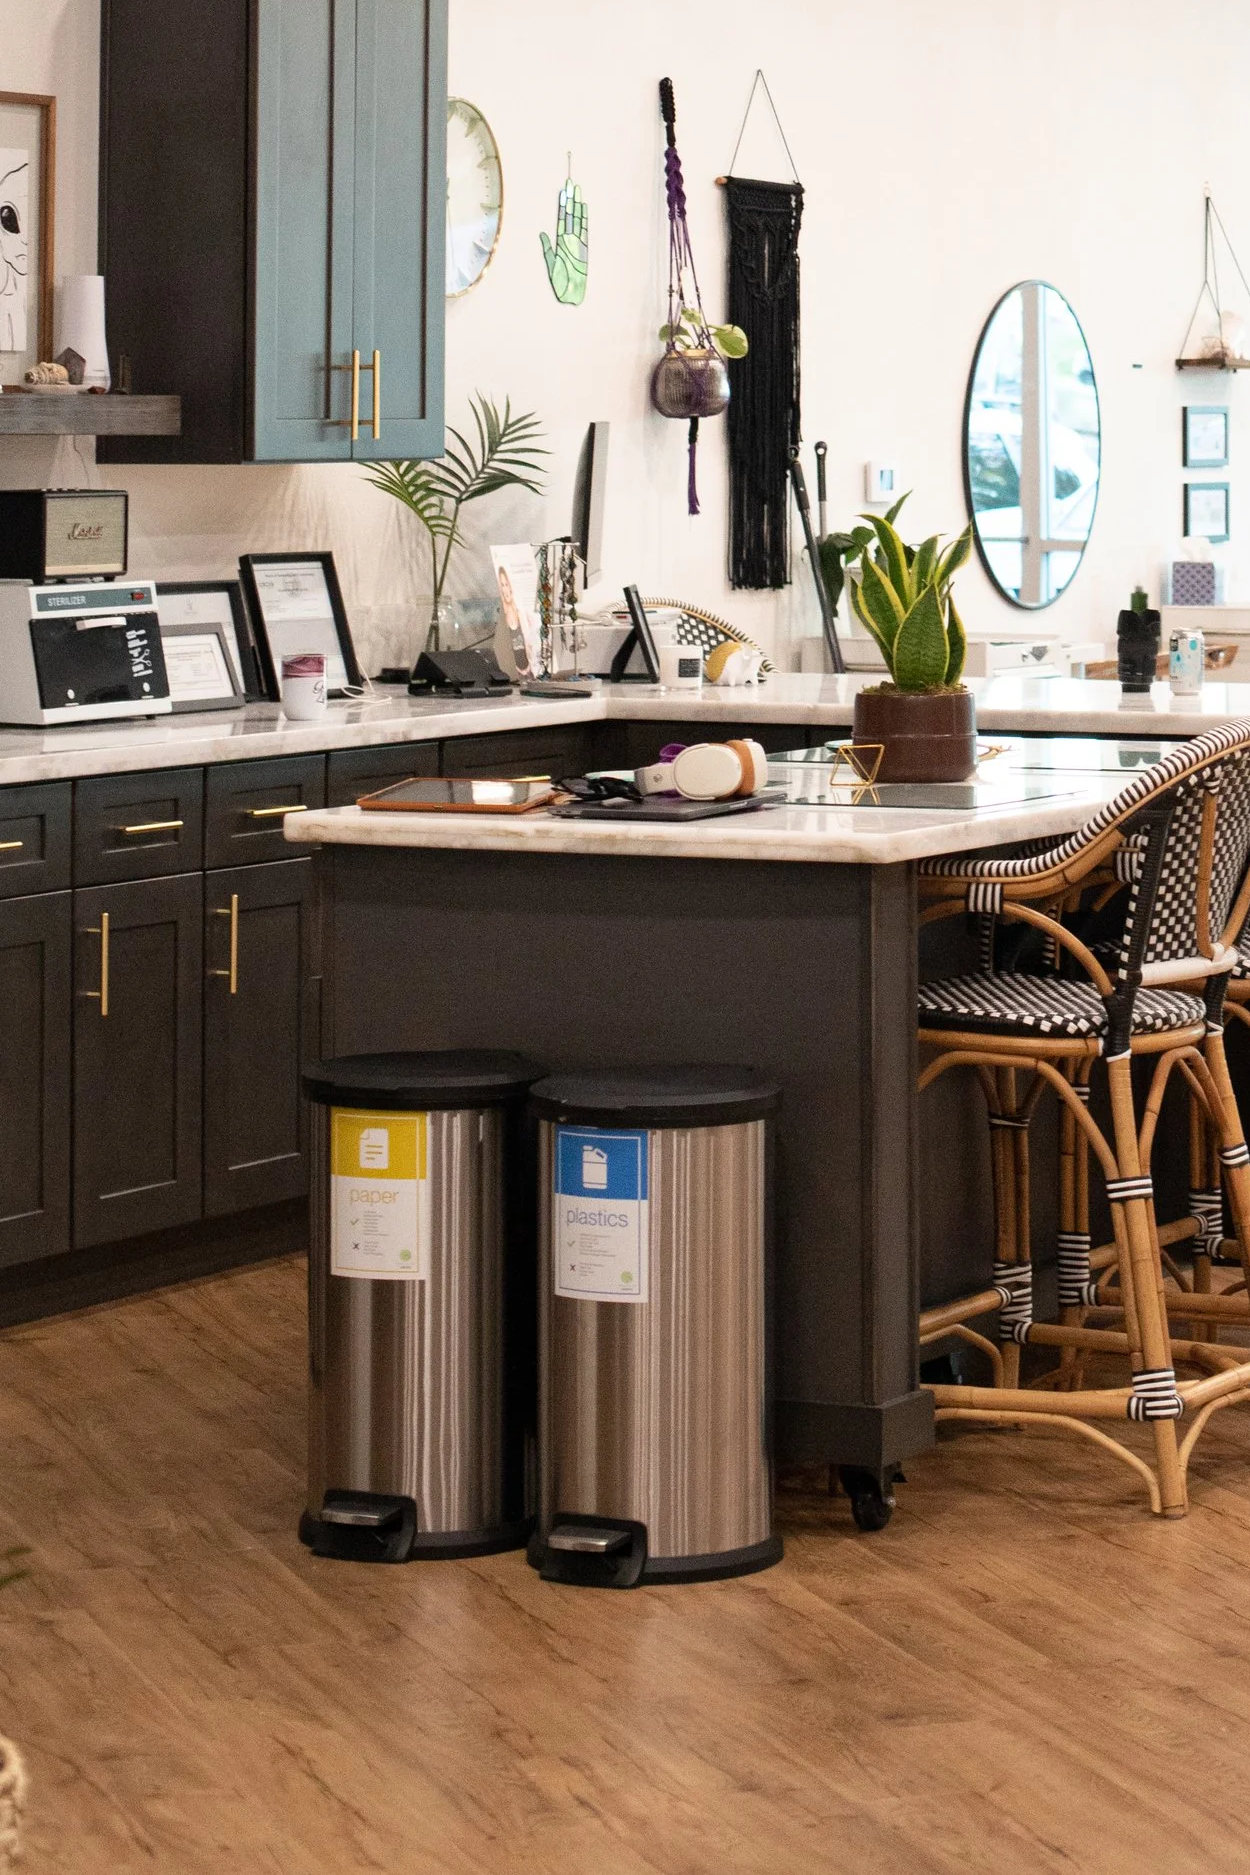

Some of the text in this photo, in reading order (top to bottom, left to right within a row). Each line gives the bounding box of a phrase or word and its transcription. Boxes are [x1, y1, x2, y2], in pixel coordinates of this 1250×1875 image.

[47, 595, 87, 607] STERILIZER
[350, 1188, 399, 1207] paper
[566, 1207, 629, 1228] plastics
